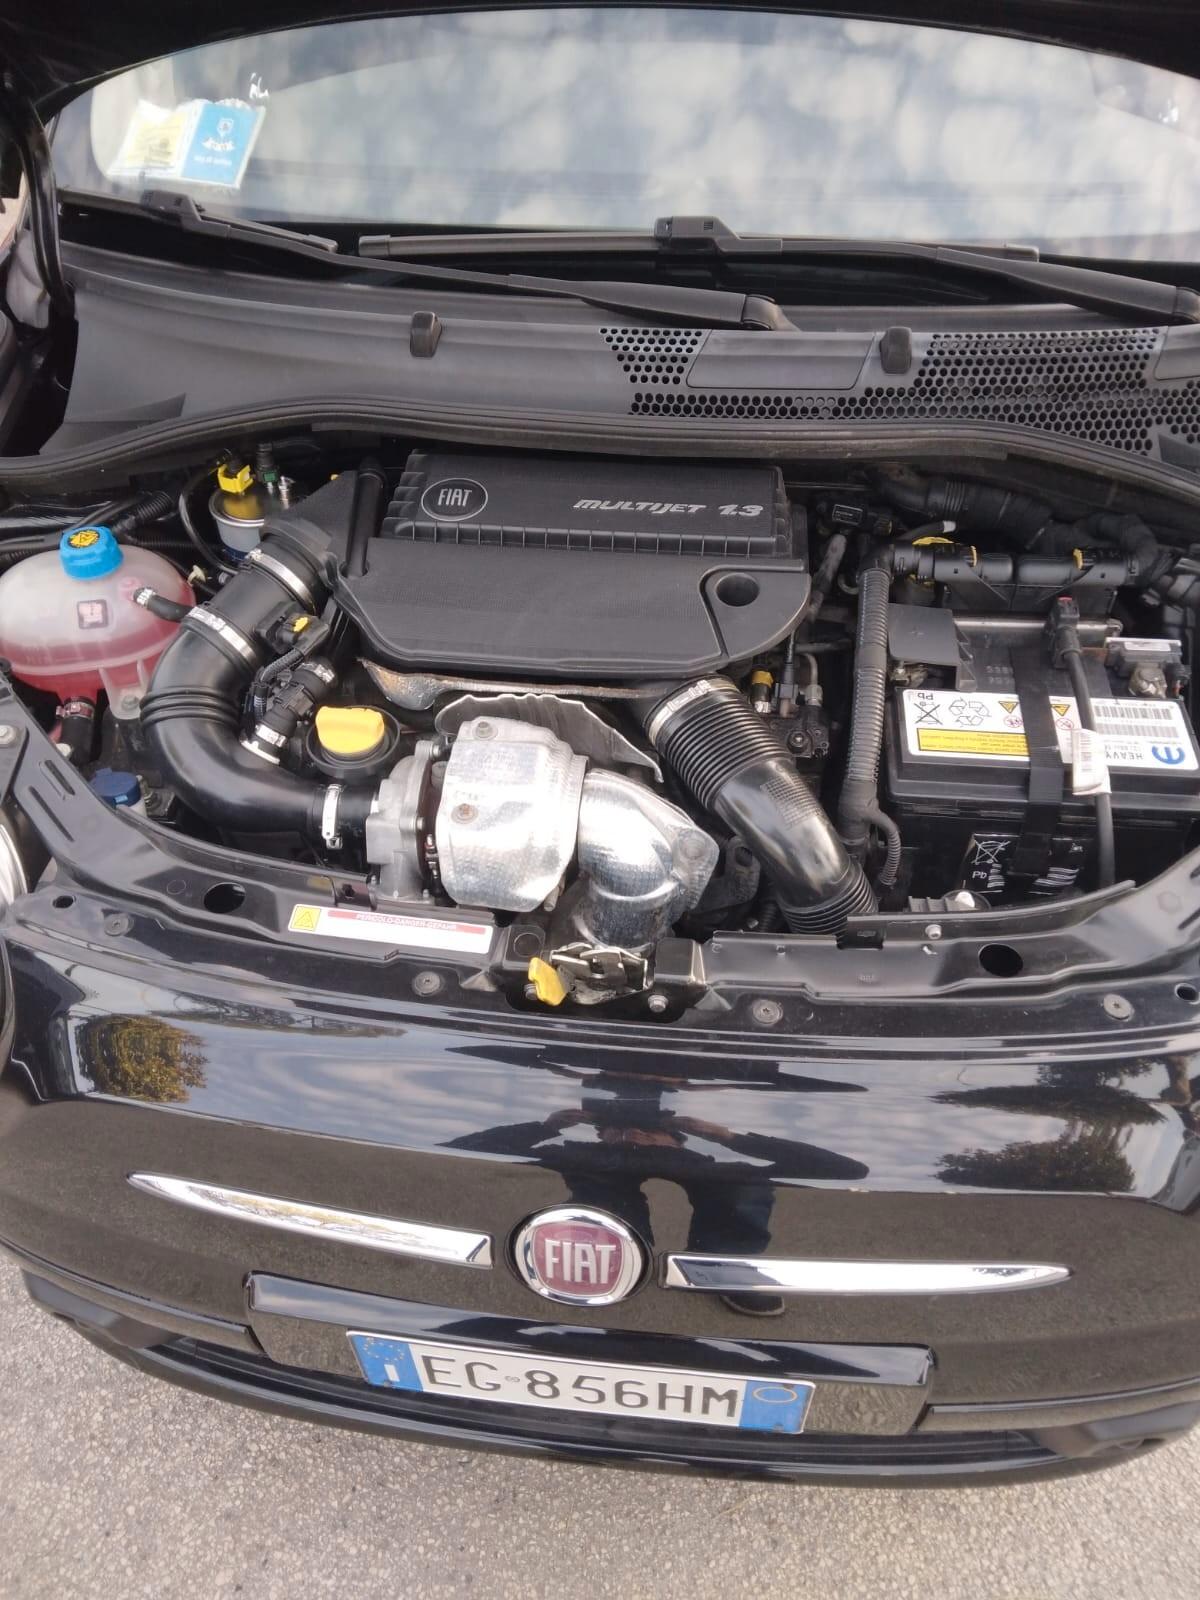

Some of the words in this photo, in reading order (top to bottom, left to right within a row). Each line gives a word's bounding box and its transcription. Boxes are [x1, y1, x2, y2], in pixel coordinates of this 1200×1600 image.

[437, 488, 473, 507] FIAT
[572, 499, 707, 515] MULTIJET
[717, 503, 764, 518] 1.3
[971, 870, 988, 879] Pb
[544, 1239, 617, 1285] FIAT
[420, 1354, 501, 1393] EG
[524, 1368, 740, 1419] 856HM
